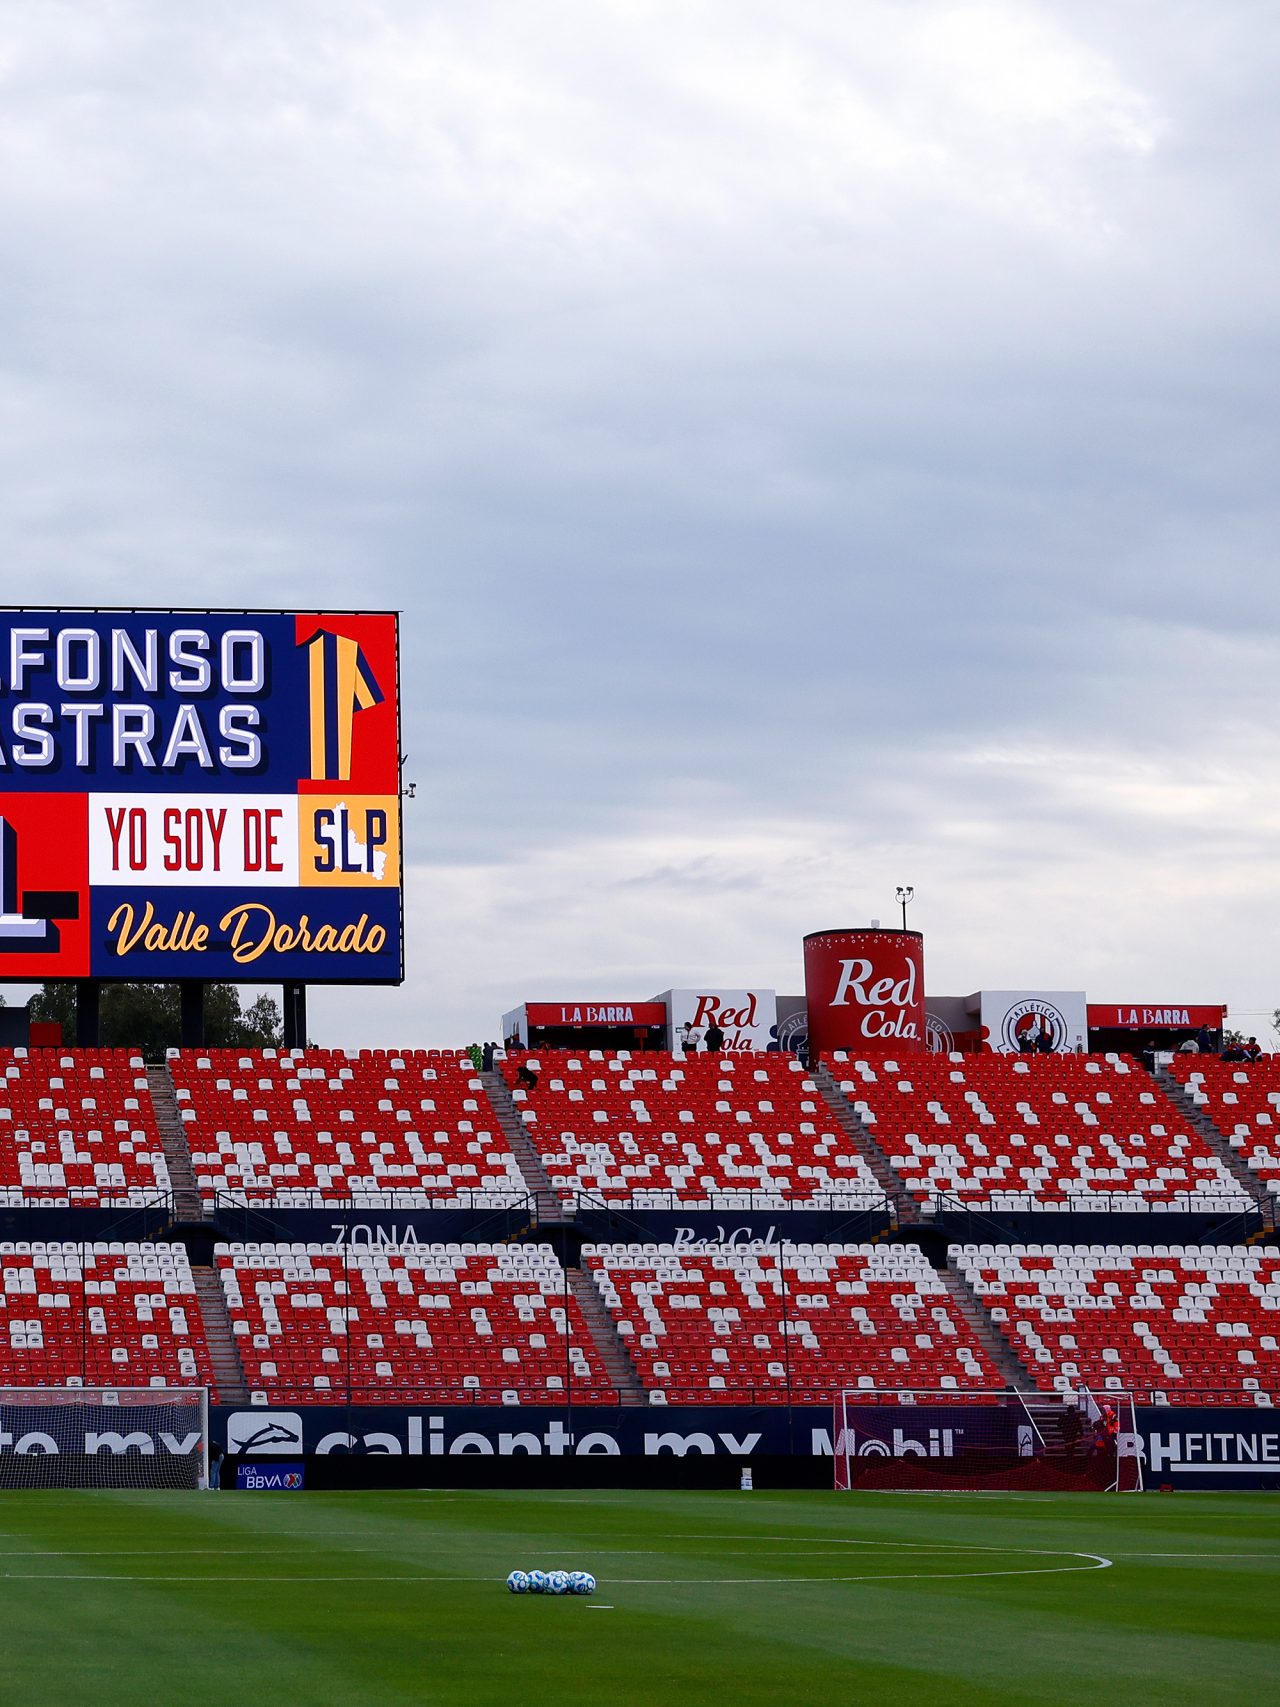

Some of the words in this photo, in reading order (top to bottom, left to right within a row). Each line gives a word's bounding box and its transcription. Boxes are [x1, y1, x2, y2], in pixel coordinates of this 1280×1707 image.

[105, 807, 147, 871] YO
[163, 808, 227, 872] SOY
[243, 808, 283, 872] DE
[314, 808, 387, 873] SLP
[108, 901, 209, 956] Valle
[220, 903, 387, 963] Dorado
[829, 957, 919, 1007] Red
[561, 1007, 582, 1022] LA
[586, 1006, 634, 1022] BARRA
[691, 992, 760, 1028] Red
[1013, 1003, 1055, 1019] ATLÉTICO
[1117, 1009, 1139, 1024] LA
[1142, 1009, 1190, 1025] BARRA
[860, 1009, 918, 1040] Cola
[721, 1030, 754, 1051] ola
[237, 1466, 257, 1476] LIGA
[246, 1474, 282, 1489] BBVA
